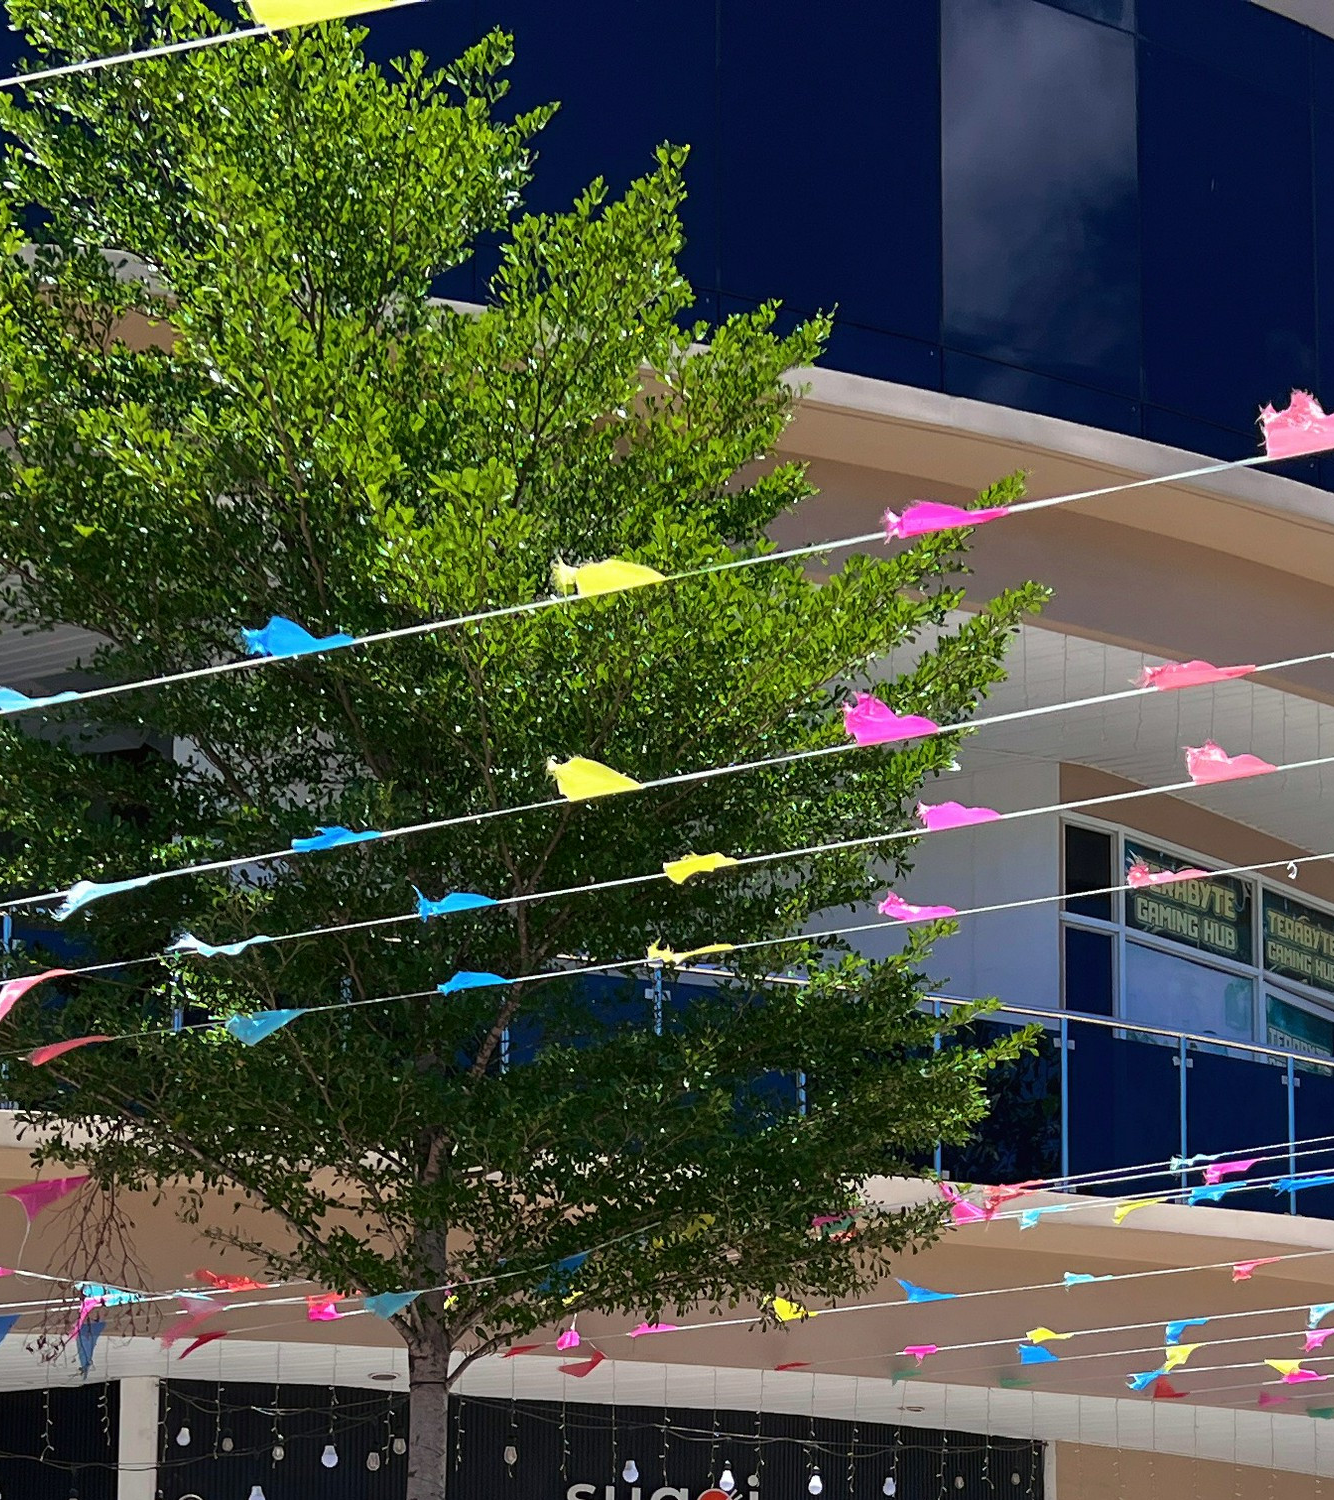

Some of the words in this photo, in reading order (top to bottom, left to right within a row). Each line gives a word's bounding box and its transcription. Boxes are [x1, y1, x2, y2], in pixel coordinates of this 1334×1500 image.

[1147, 864, 1236, 919] ERABYTE
[1136, 897, 1199, 938] GAMING
[1204, 919, 1237, 951] HUB
[1267, 941, 1313, 974] GAMING
